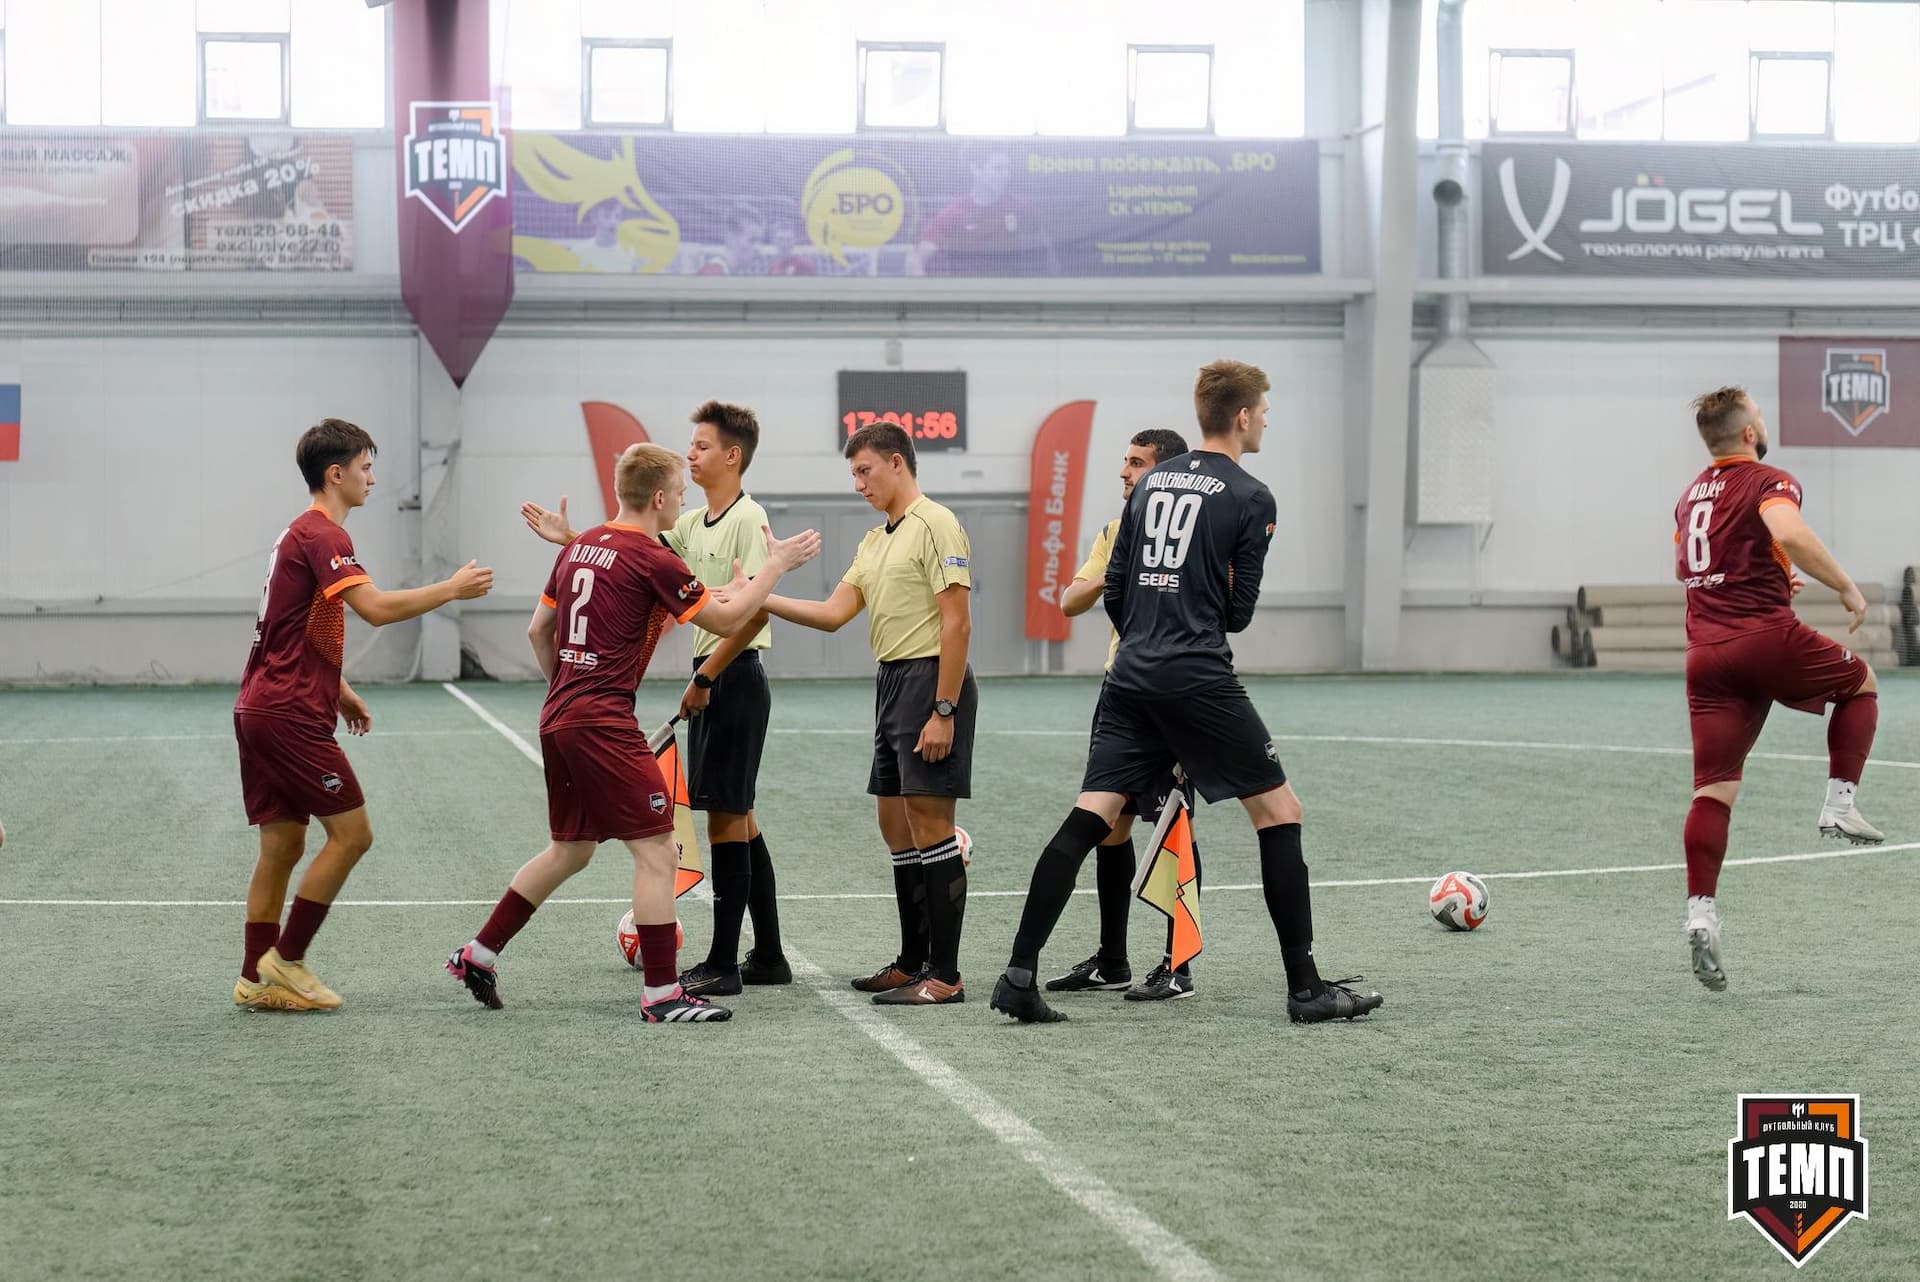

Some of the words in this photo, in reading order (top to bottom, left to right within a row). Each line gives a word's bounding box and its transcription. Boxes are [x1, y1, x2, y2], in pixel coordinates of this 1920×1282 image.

[43, 149, 126, 165] МАССАЖ
[264, 156, 320, 190] 20%
[414, 138, 496, 183] ТЕМП
[1028, 153, 1095, 175] Время
[1101, 154, 1221, 175] побеждать,
[1227, 152, 1277, 172] .БРО
[831, 192, 894, 216] .БРО
[1580, 173, 1824, 235] JÖGEL
[1580, 243, 1702, 258] технологии
[1706, 245, 1824, 261] результата
[1838, 220, 1905, 252] ТРЦ
[1829, 372, 1884, 404] ТЕМП
[1045, 450, 1070, 516] Банк
[1142, 491, 1203, 569] 99
[1687, 500, 1714, 573] 8
[569, 543, 618, 570] ПЛУГИН
[1038, 520, 1065, 605] Альфа
[568, 567, 596, 646] 2
